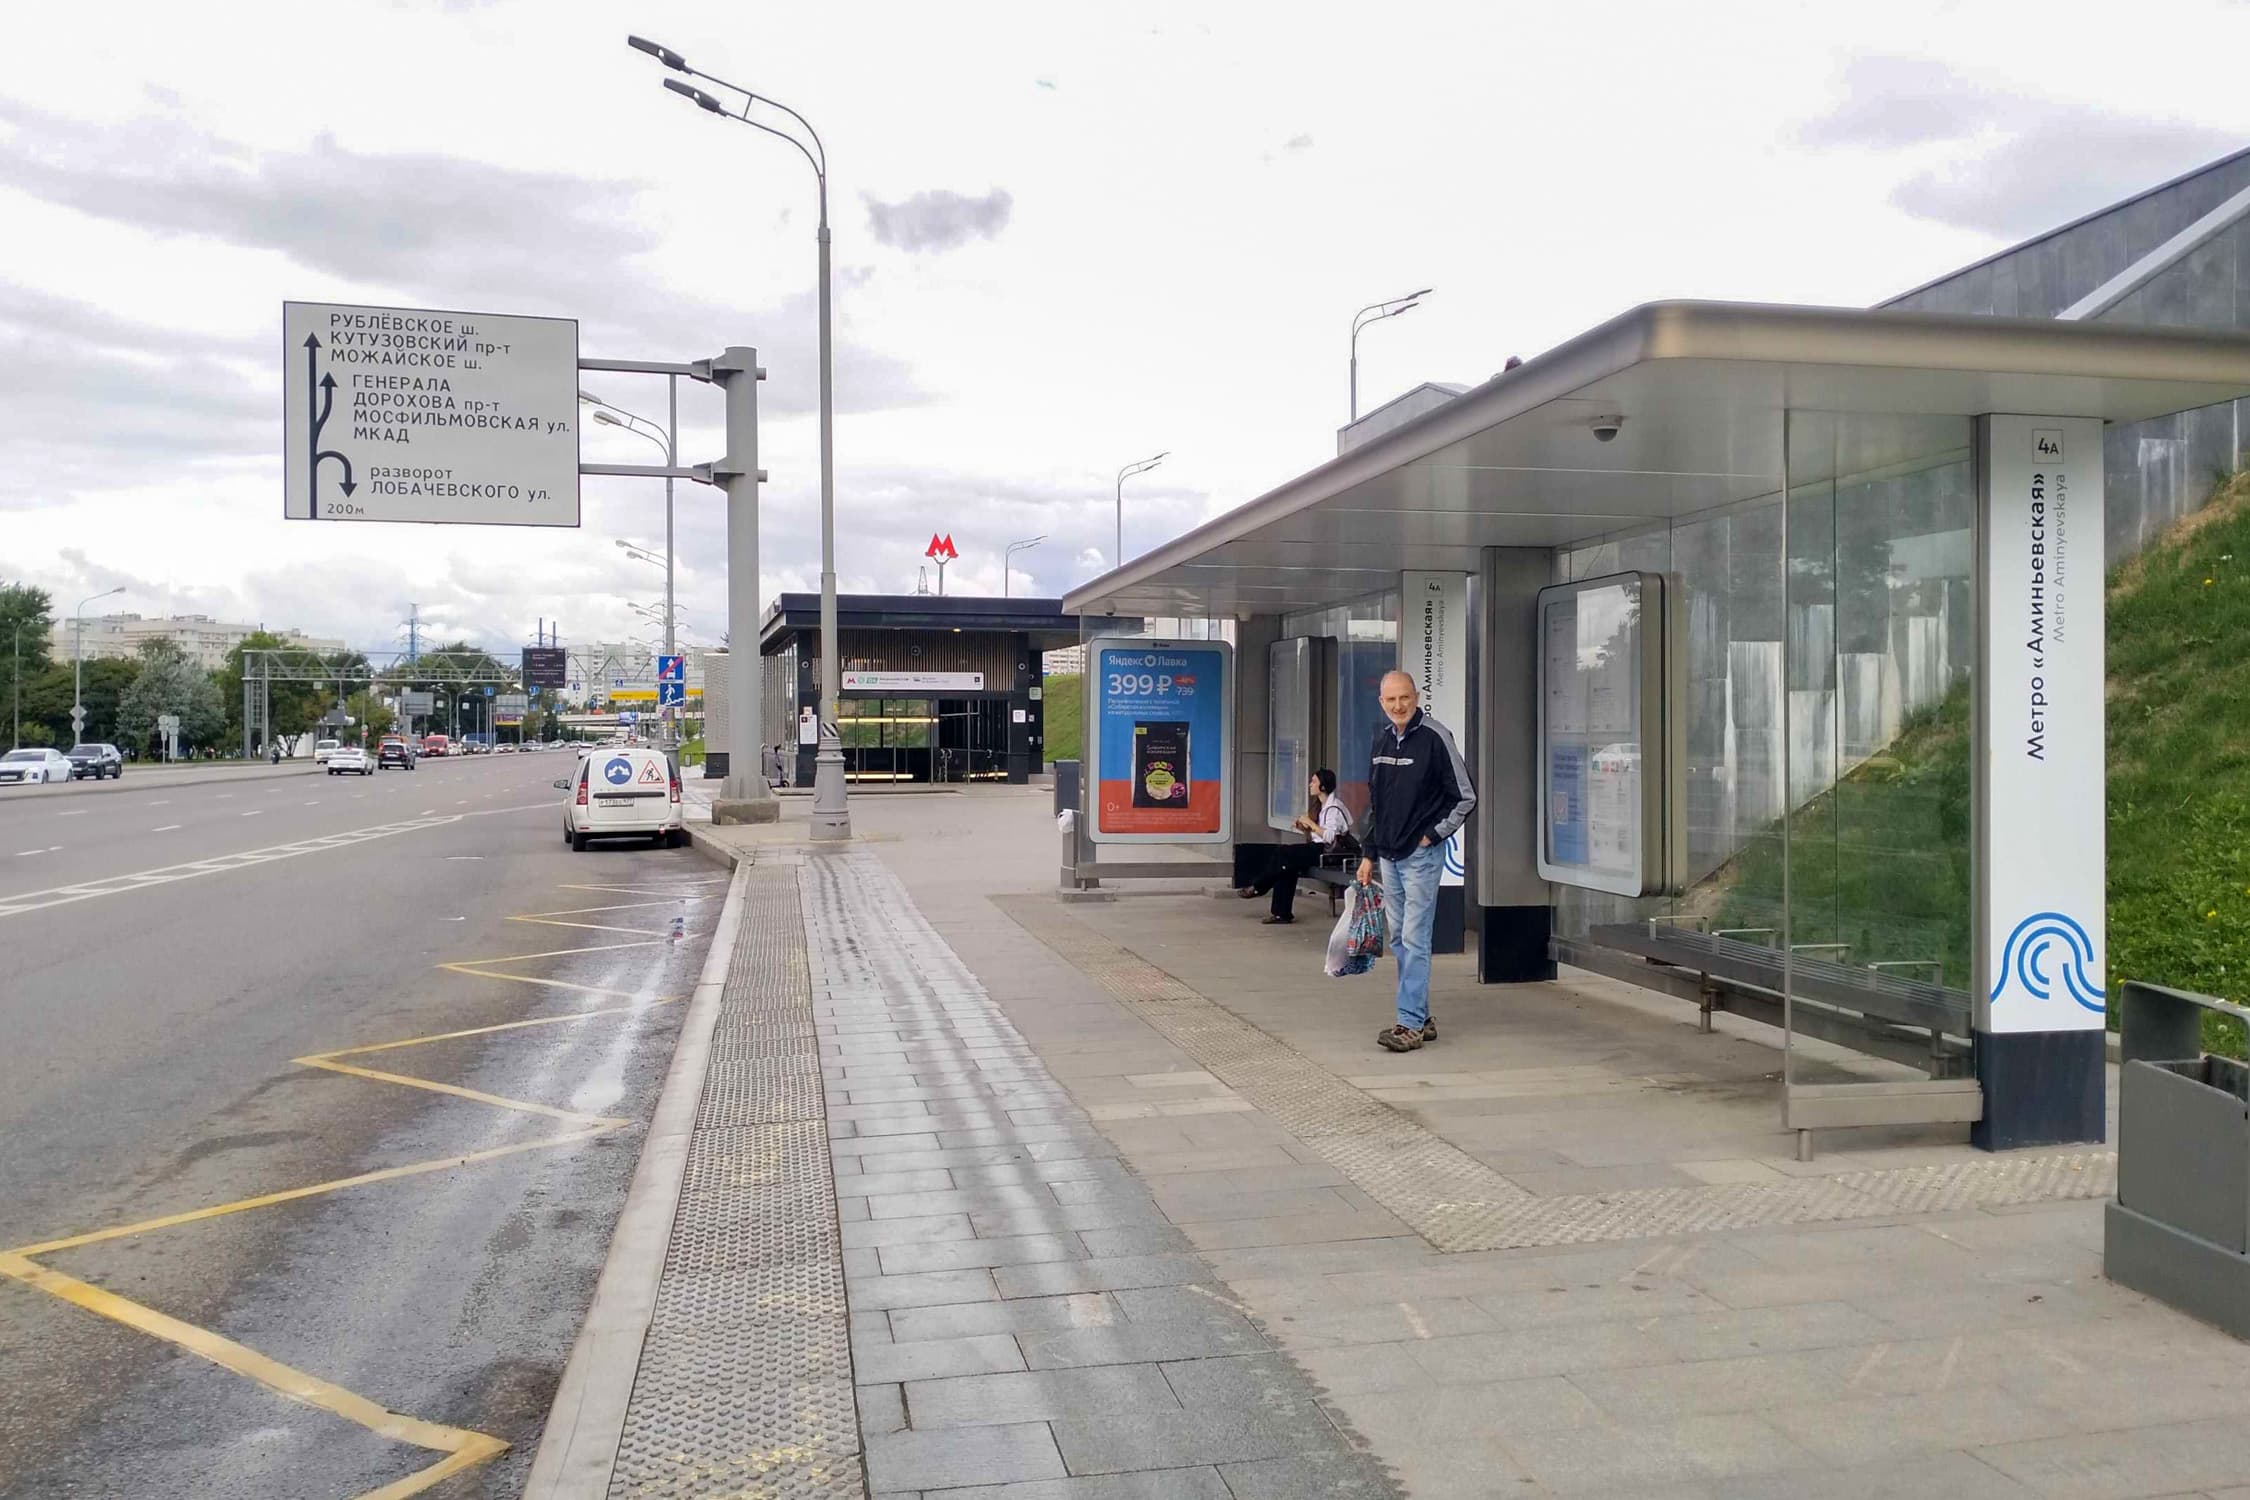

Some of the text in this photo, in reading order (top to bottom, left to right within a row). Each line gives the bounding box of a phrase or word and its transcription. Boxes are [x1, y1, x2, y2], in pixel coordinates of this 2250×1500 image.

[330, 313, 479, 336] РУБЛЁВСКОЕ ш.
[331, 331, 511, 356] КУТУЗОВСКИЙ пр-т
[331, 348, 482, 370] МОЖАЙСКОЕ ш.
[352, 374, 451, 392] ГЕНЕРАЛА
[353, 392, 500, 413] ДОРОХОВА пр-т
[353, 410, 570, 433] МОСФИЛЬМОВСКАЯ ул.
[353, 427, 410, 444] МКАД
[370, 466, 453, 481] разворот
[370, 481, 551, 502] ЛОБАЧЕВСКОГО ул.
[327, 503, 364, 515] 200м
[2053, 473, 2067, 643] Metro Aminyevskaya
[2026, 472, 2048, 761] Метро «Аминьевская»
[1108, 655, 1187, 667] Яндекс Лавка
[1422, 600, 1433, 700] «Аминьевская»
[1107, 673, 1154, 696] 399
